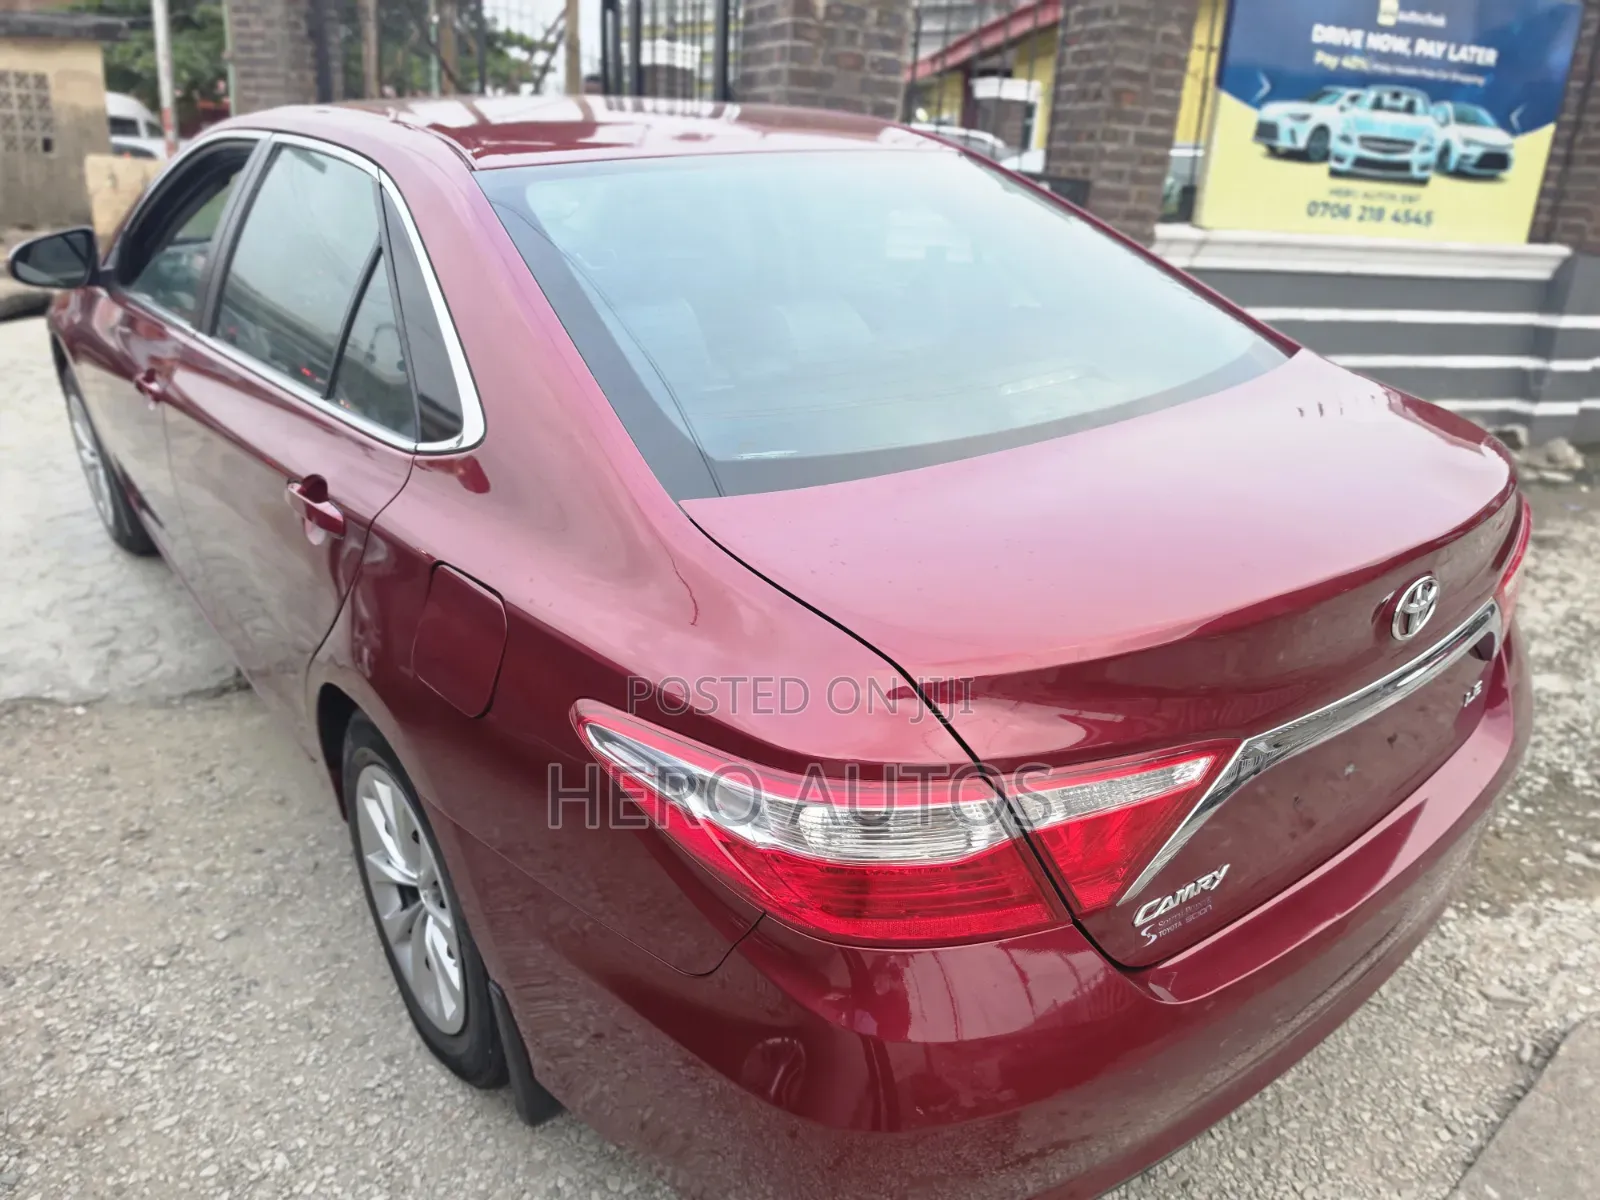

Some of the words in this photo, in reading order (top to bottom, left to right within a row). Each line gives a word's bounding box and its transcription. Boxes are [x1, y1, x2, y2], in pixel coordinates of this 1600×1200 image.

[1311, 24, 1364, 49] DRIVE
[1366, 33, 1412, 57] NOW,
[1414, 38, 1447, 59] PAY
[1448, 43, 1498, 67] LATER
[1314, 50, 1340, 70] Pay
[1307, 199, 1352, 219] 0706
[1463, 680, 1483, 707] LE
[1132, 863, 1231, 928] CAMRY
[1158, 921, 1182, 938] TOYOTA
